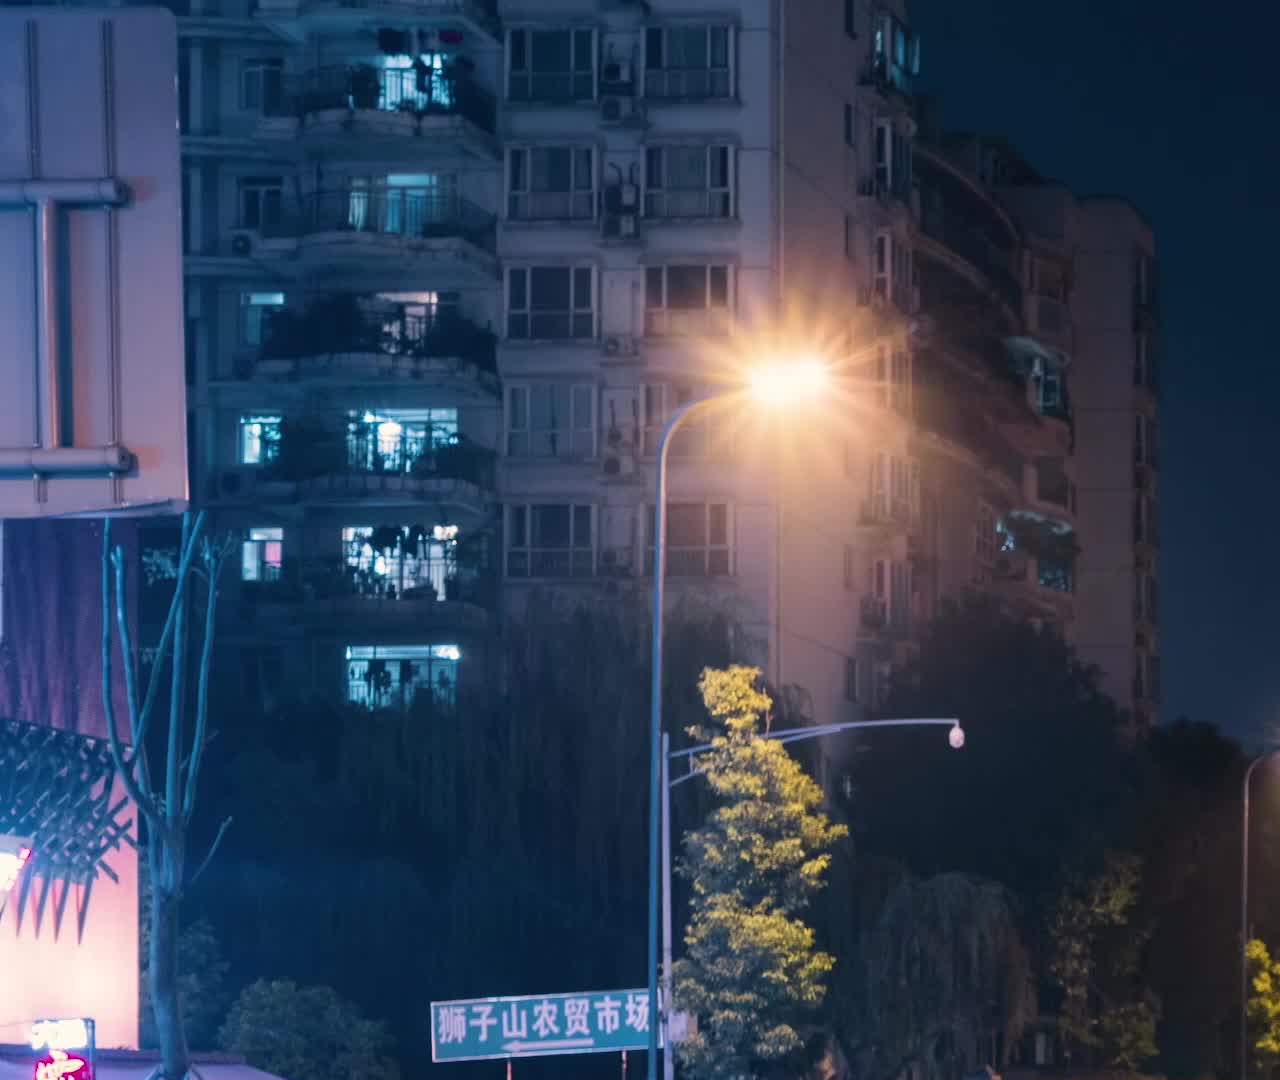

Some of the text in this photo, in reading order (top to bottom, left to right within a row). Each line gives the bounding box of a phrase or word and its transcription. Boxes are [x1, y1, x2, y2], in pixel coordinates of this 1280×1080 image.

[438, 994, 650, 1044] 狮子山农贸市场
